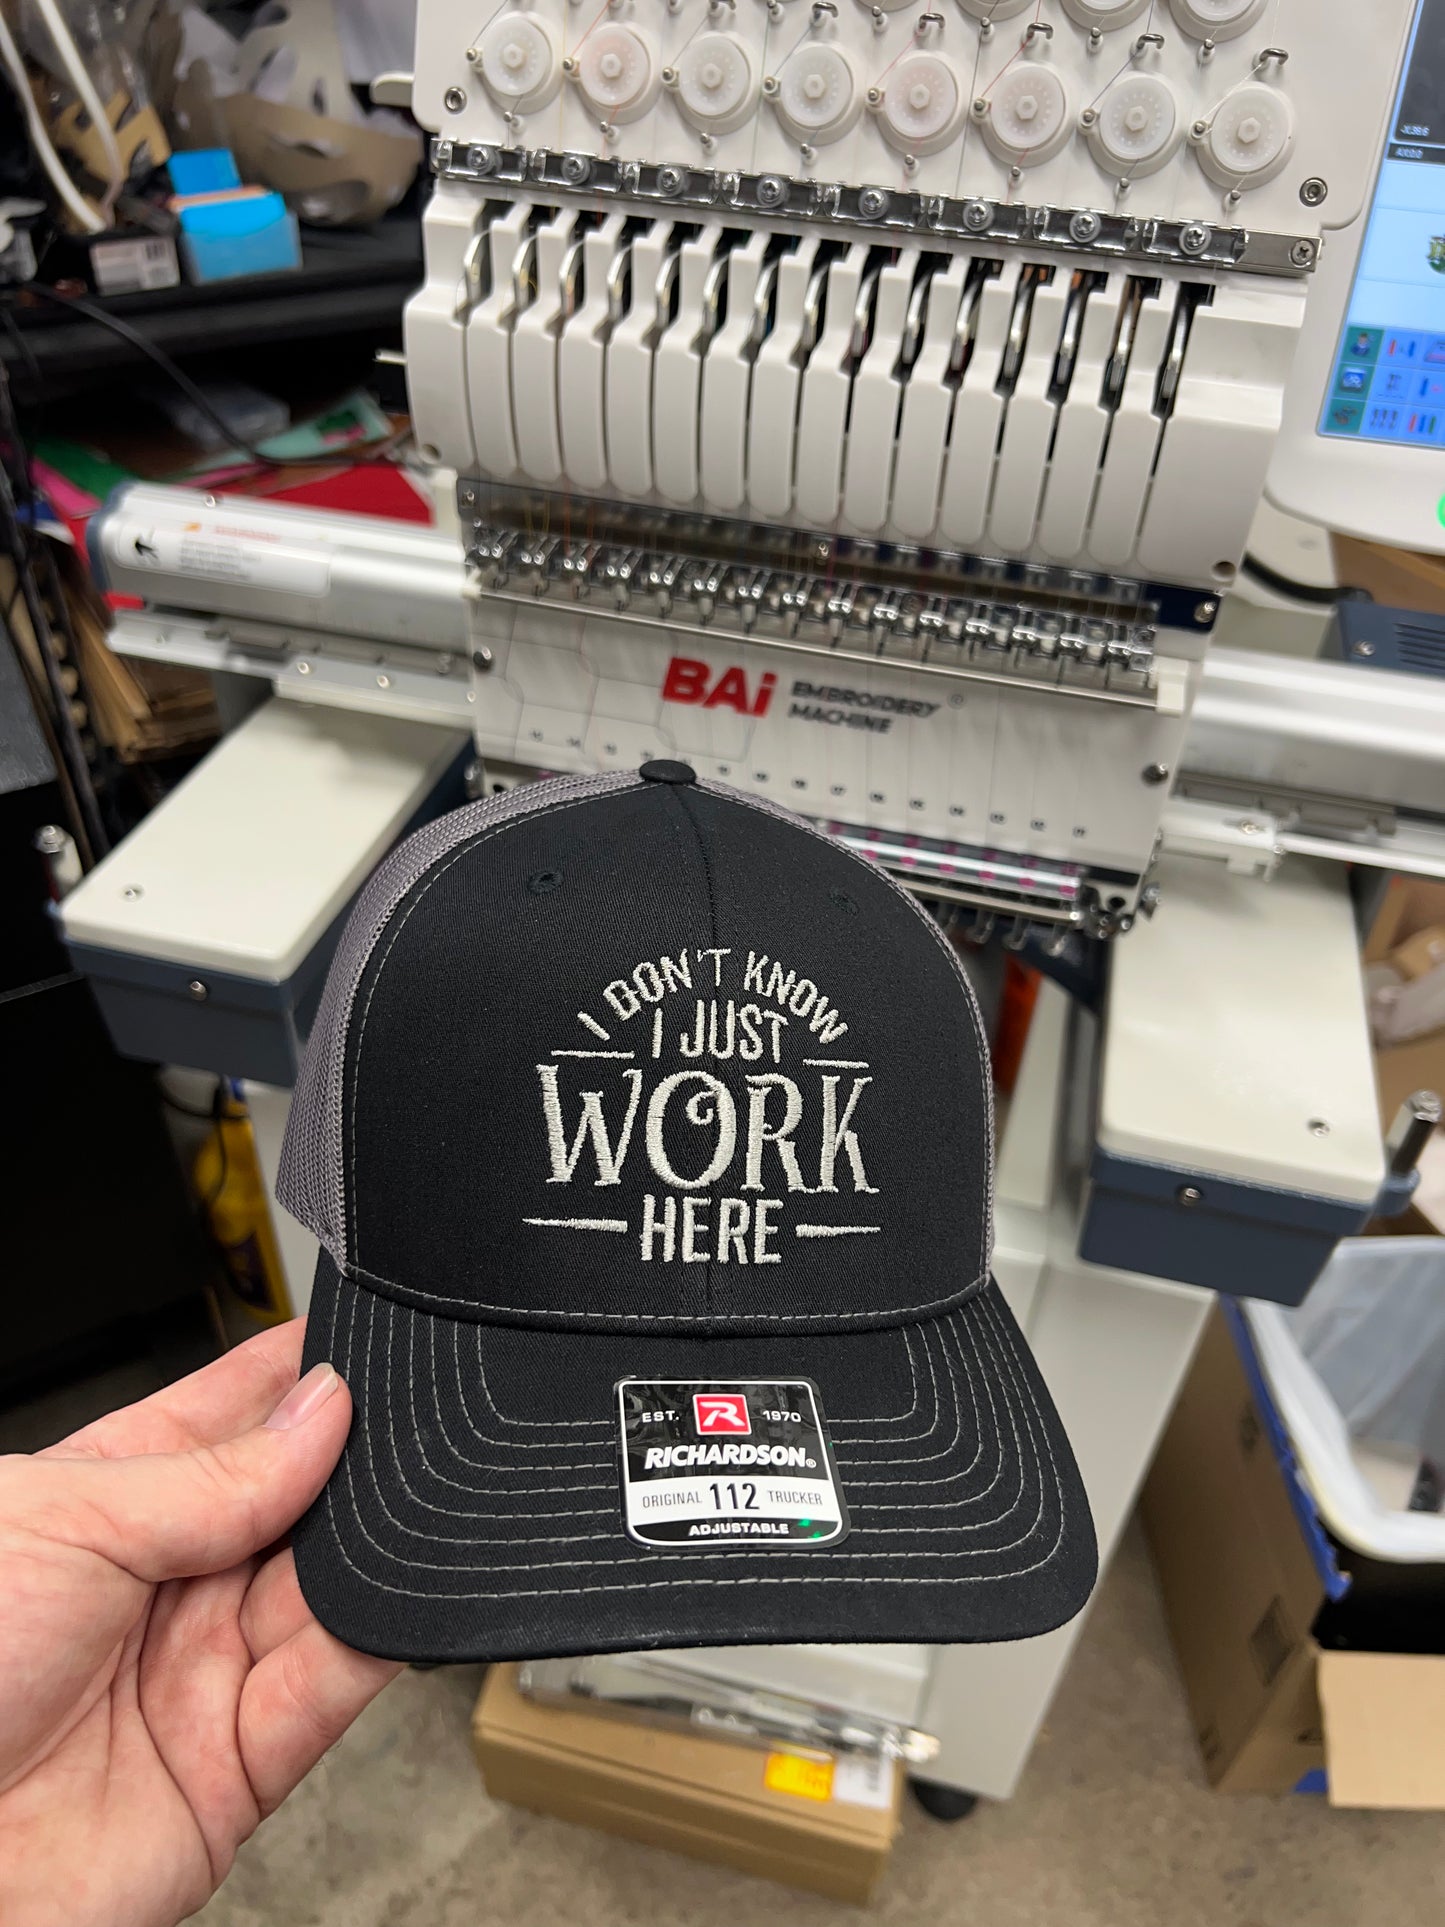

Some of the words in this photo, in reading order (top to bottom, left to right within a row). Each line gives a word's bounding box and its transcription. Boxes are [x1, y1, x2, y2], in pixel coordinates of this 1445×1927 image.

[789, 703, 891, 733] MACHINE
[790, 680, 941, 718] EMBROIDERY
[577, 1011, 610, 1041] I
[603, 948, 731, 1021] DON'T
[744, 951, 848, 1044] KNOW
[652, 1008, 663, 1058] I
[680, 999, 789, 1063] JUST
[535, 1064, 879, 1194] WORK
[640, 1194, 783, 1264] HERE
[642, 1410, 680, 1423] EST.
[762, 1410, 801, 1423] 1970
[642, 1489, 703, 1508] ORIGINAL
[709, 1483, 759, 1510] 112
[767, 1490, 823, 1506] TRUCKER
[689, 1522, 789, 1536] ADJUSTABLE
